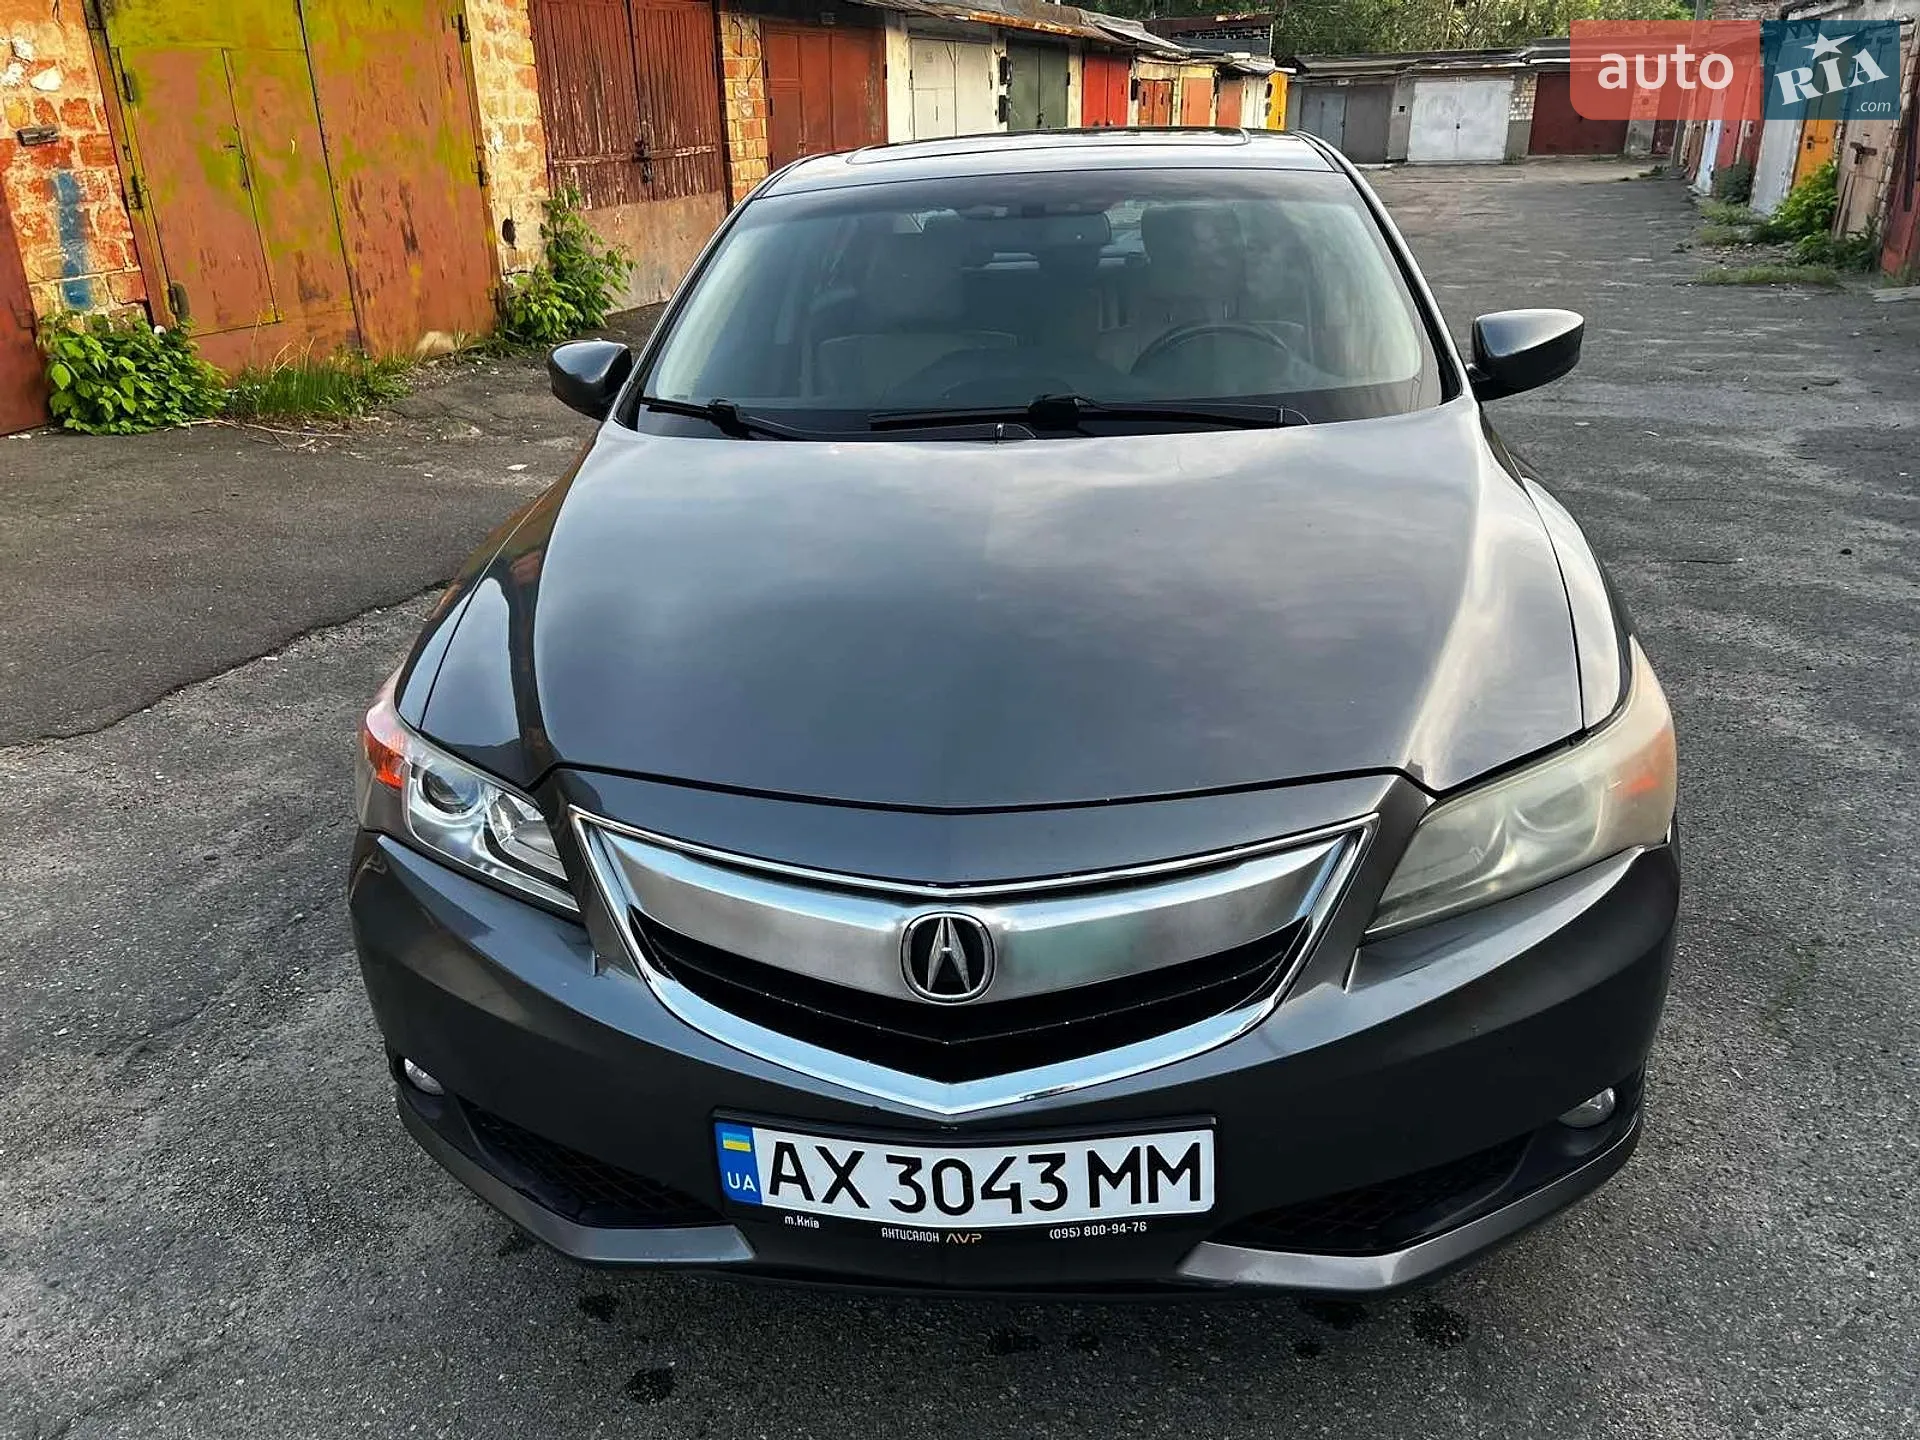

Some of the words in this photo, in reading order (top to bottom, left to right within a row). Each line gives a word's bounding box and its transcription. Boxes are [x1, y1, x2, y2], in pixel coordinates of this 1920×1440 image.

[727, 1172, 757, 1192] UA
[768, 1141, 870, 1209] AX
[886, 1152, 1069, 1216] 3043
[1087, 1142, 1201, 1208] MM
[1049, 1227, 1081, 1240] (095)
[1083, 1221, 1147, 1237] 800-94-76
